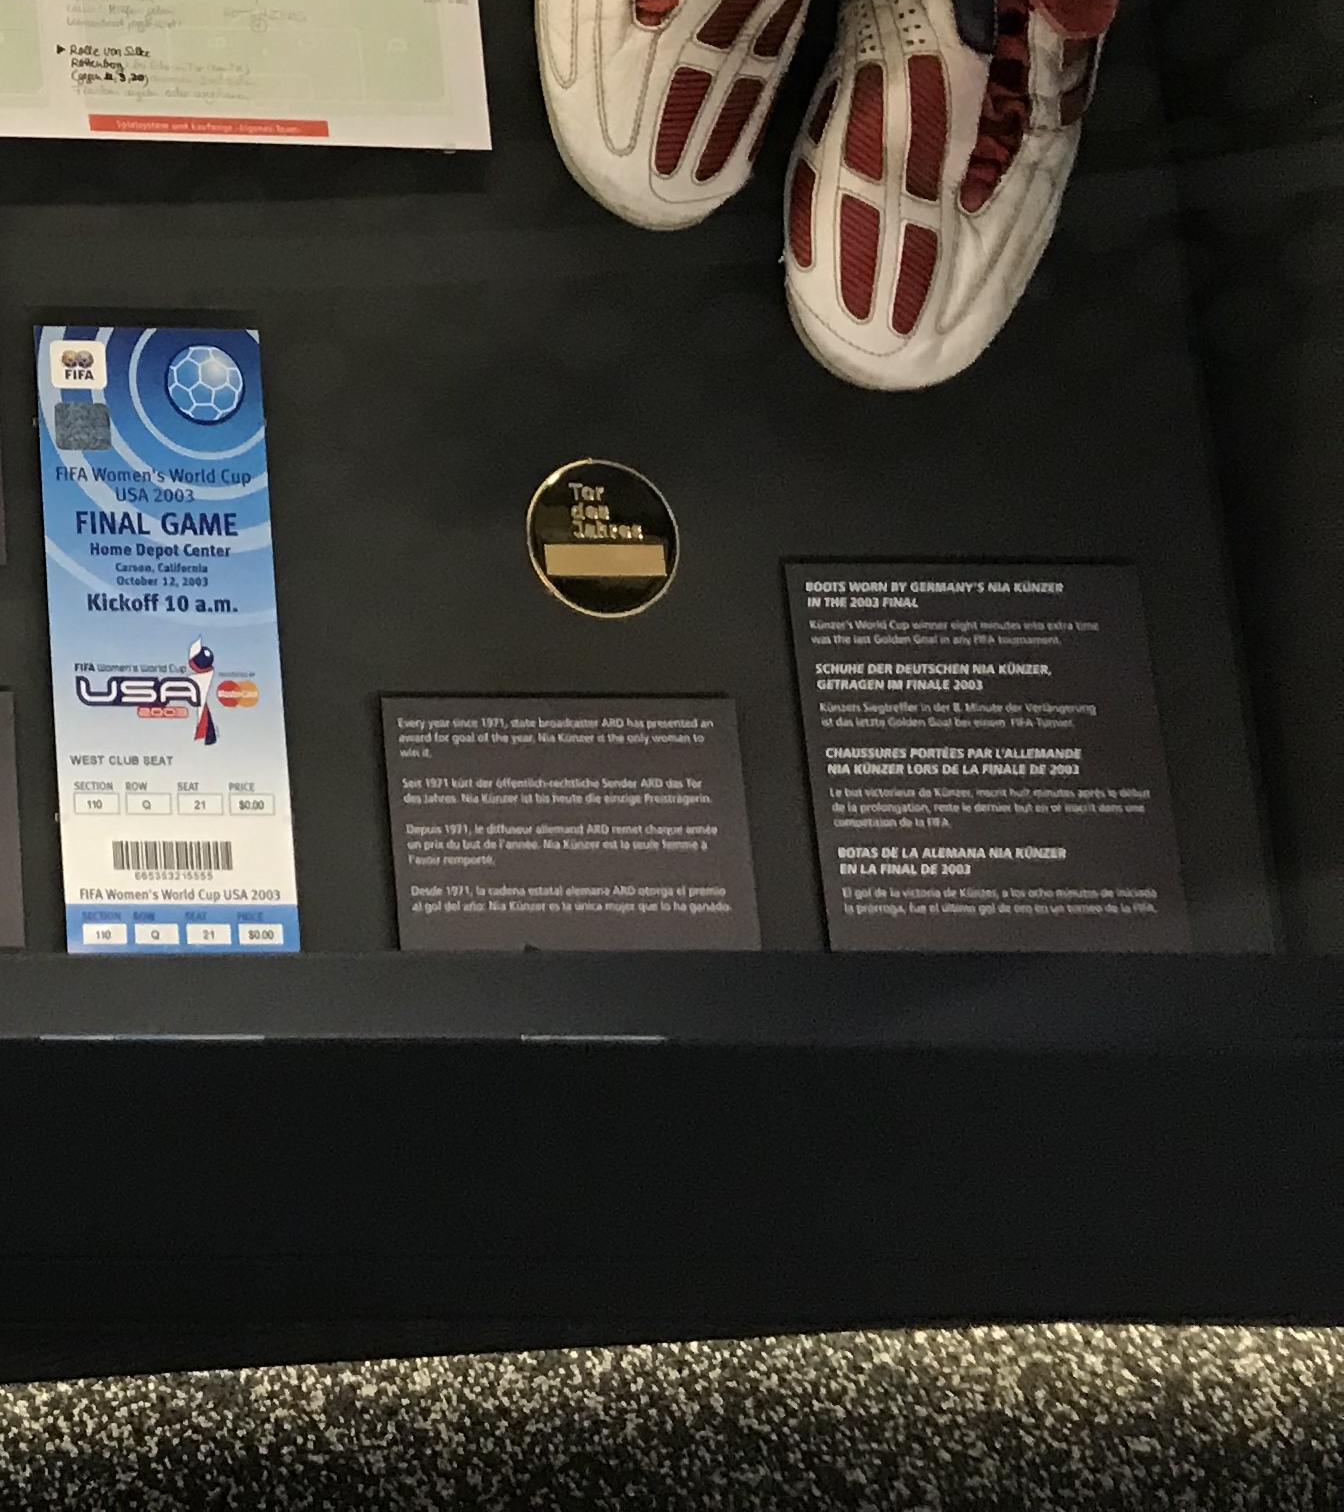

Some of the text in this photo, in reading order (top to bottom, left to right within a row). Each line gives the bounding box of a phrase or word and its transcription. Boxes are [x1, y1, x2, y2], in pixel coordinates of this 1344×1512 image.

[64, 368, 94, 380] FIFA
[55, 466, 253, 487] FIFA Women's World Cup
[114, 486, 195, 504] USA 2003
[75, 510, 238, 536] FINAL GAME
[89, 542, 231, 559] Home Depot Center
[114, 561, 208, 573] Carson, California
[116, 575, 208, 587] October 12, 2003
[87, 592, 238, 613] Kickoff 10 a.m.
[76, 676, 202, 707] USA
[137, 707, 189, 718] 2003
[68, 754, 173, 766] WEST CLUB SEAT
[73, 780, 254, 792] SECTION ROW SEAT PRICE
[86, 799, 264, 810] 110 Q 21 $0.00
[79, 887, 281, 903] FIFA Women's World Cup USA 2003
[202, 930, 215, 940] 21
